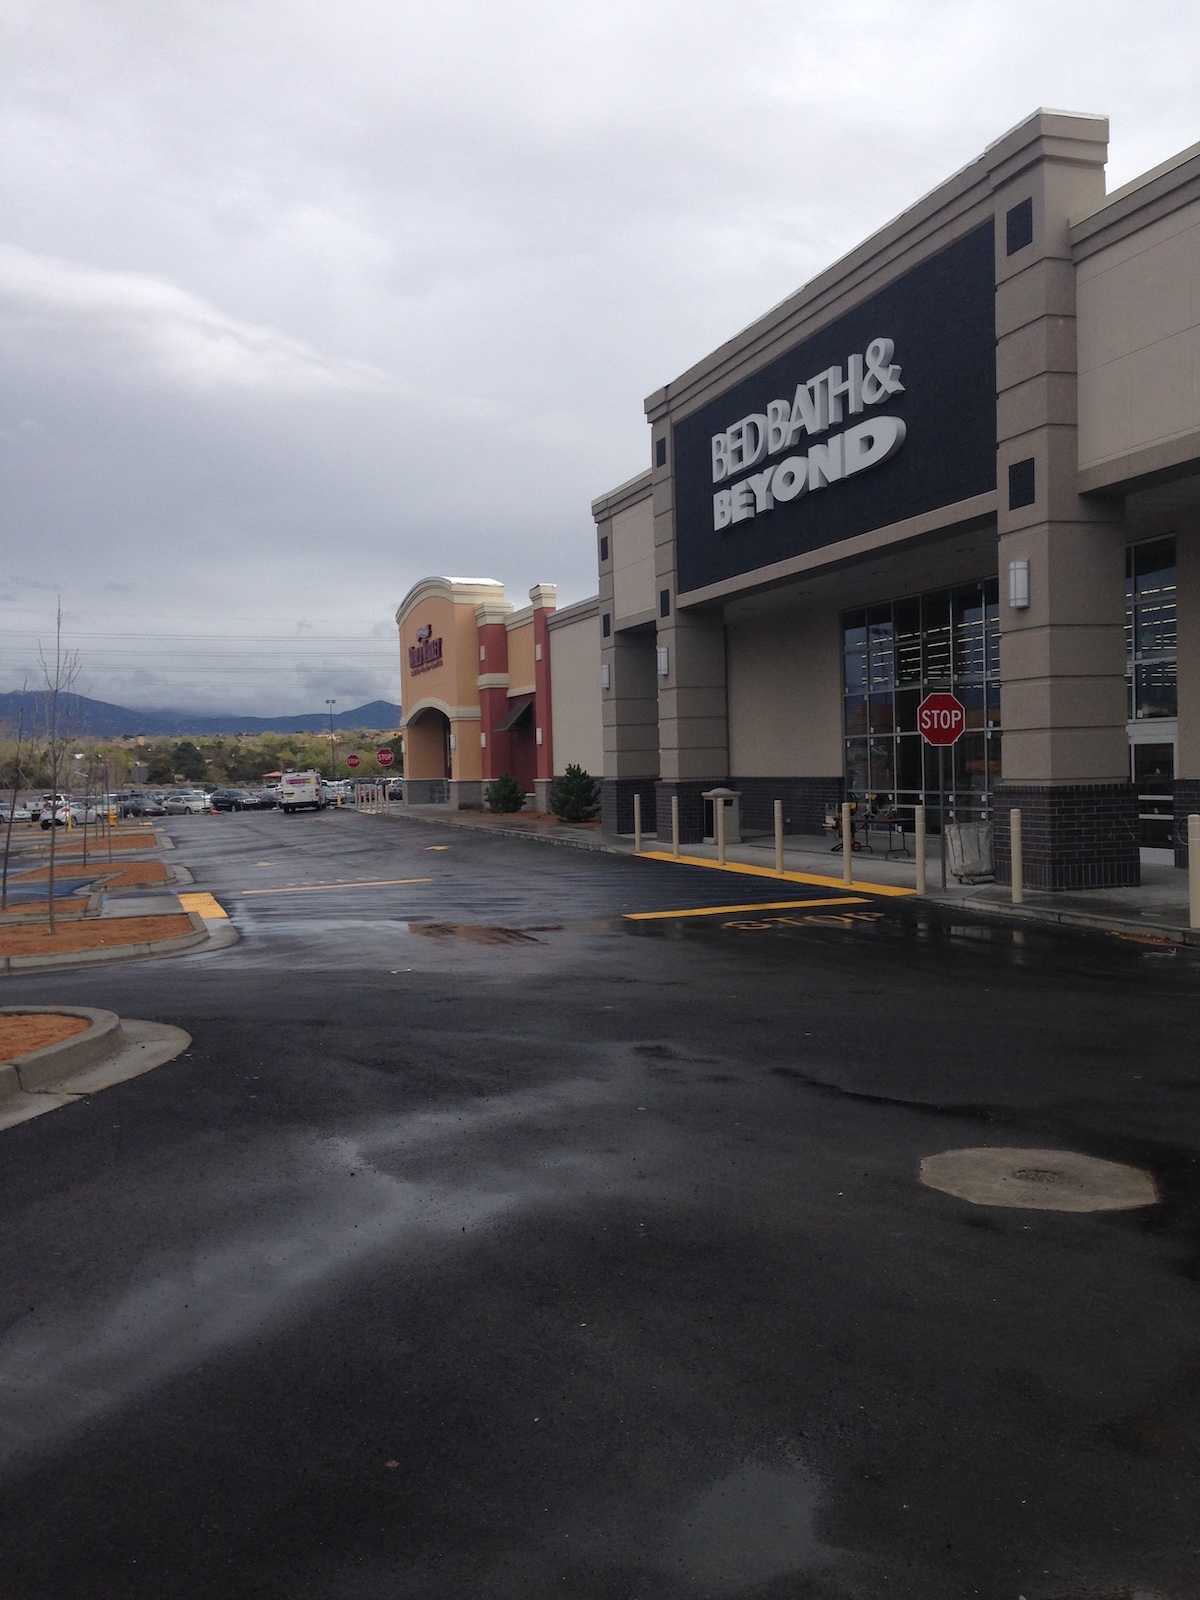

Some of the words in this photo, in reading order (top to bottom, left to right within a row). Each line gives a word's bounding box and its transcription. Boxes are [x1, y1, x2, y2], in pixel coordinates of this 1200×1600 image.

[712, 413, 768, 483] BED
[713, 416, 907, 531] BEYOND
[921, 710, 961, 729] STOP
[378, 753, 392, 761] STOP
